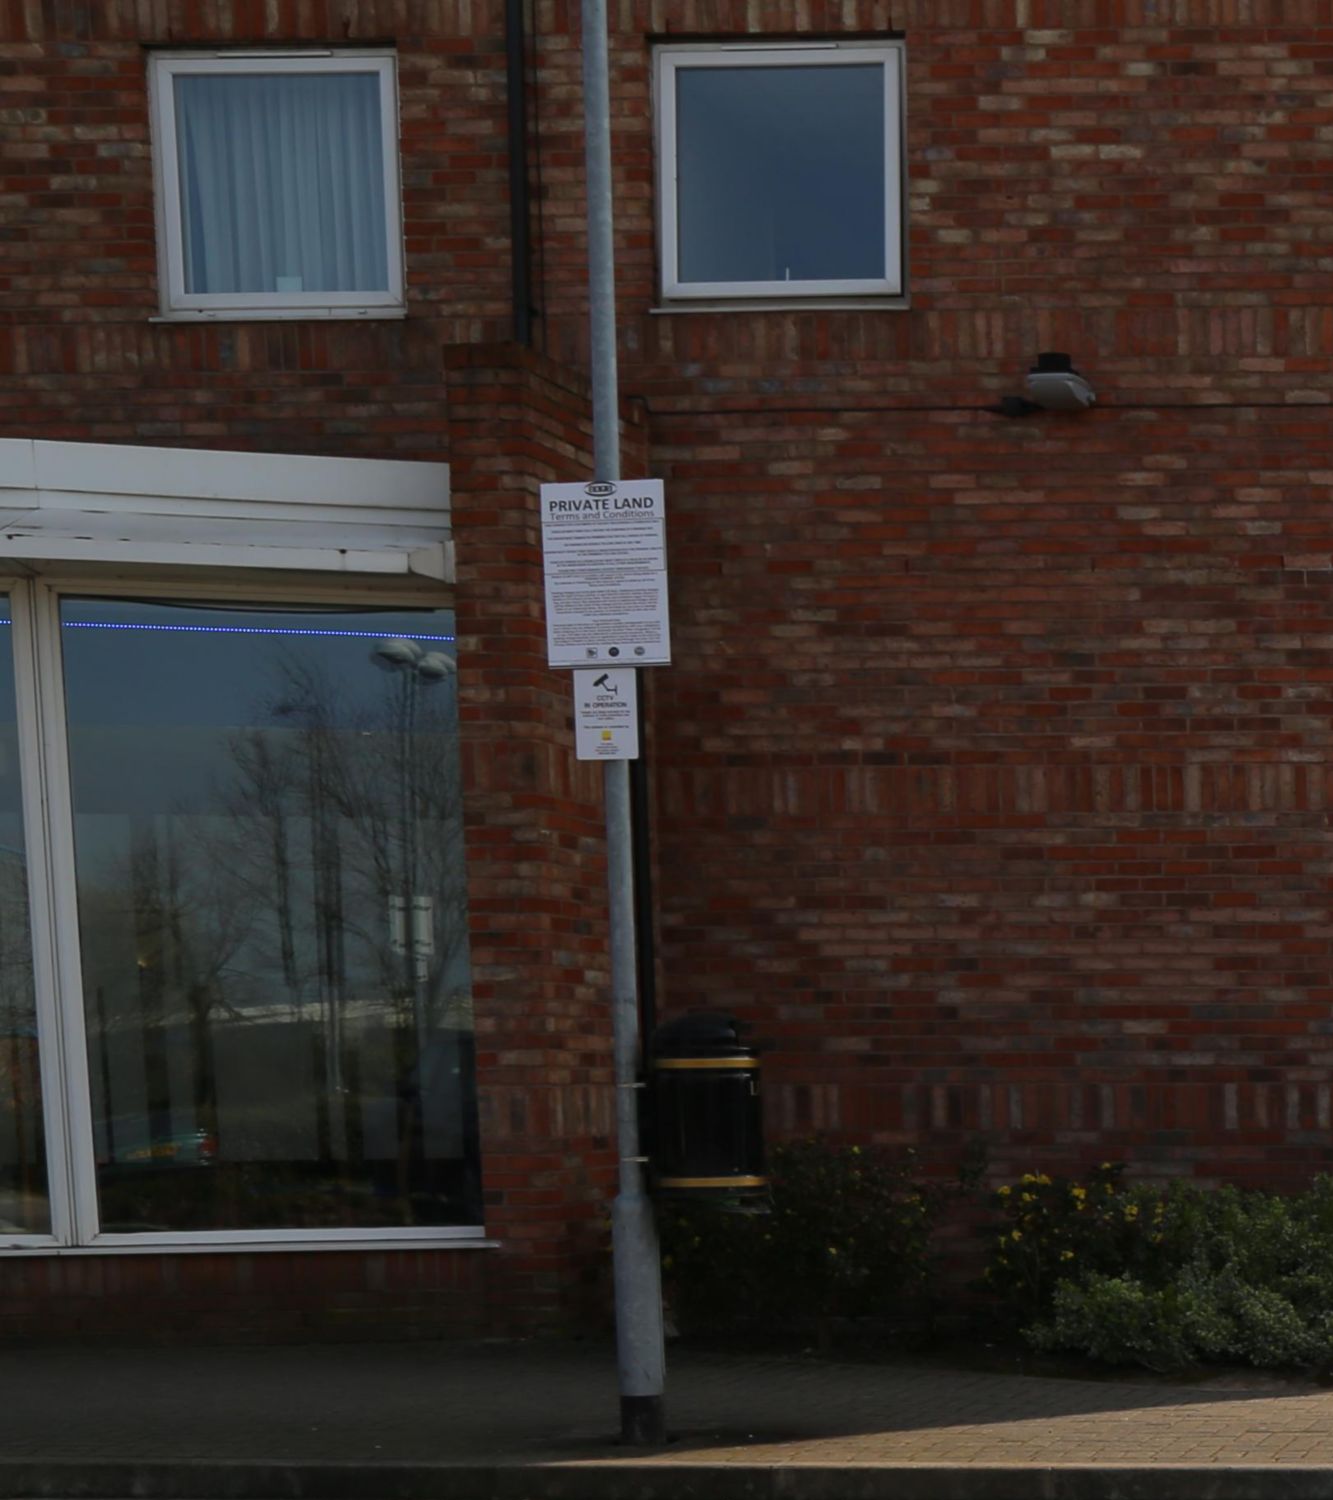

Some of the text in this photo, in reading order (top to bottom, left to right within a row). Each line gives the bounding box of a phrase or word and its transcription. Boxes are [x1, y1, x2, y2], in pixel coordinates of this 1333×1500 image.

[549, 497, 654, 512] PRIVATE LAND
[550, 509, 655, 521] Terms and Conditions
